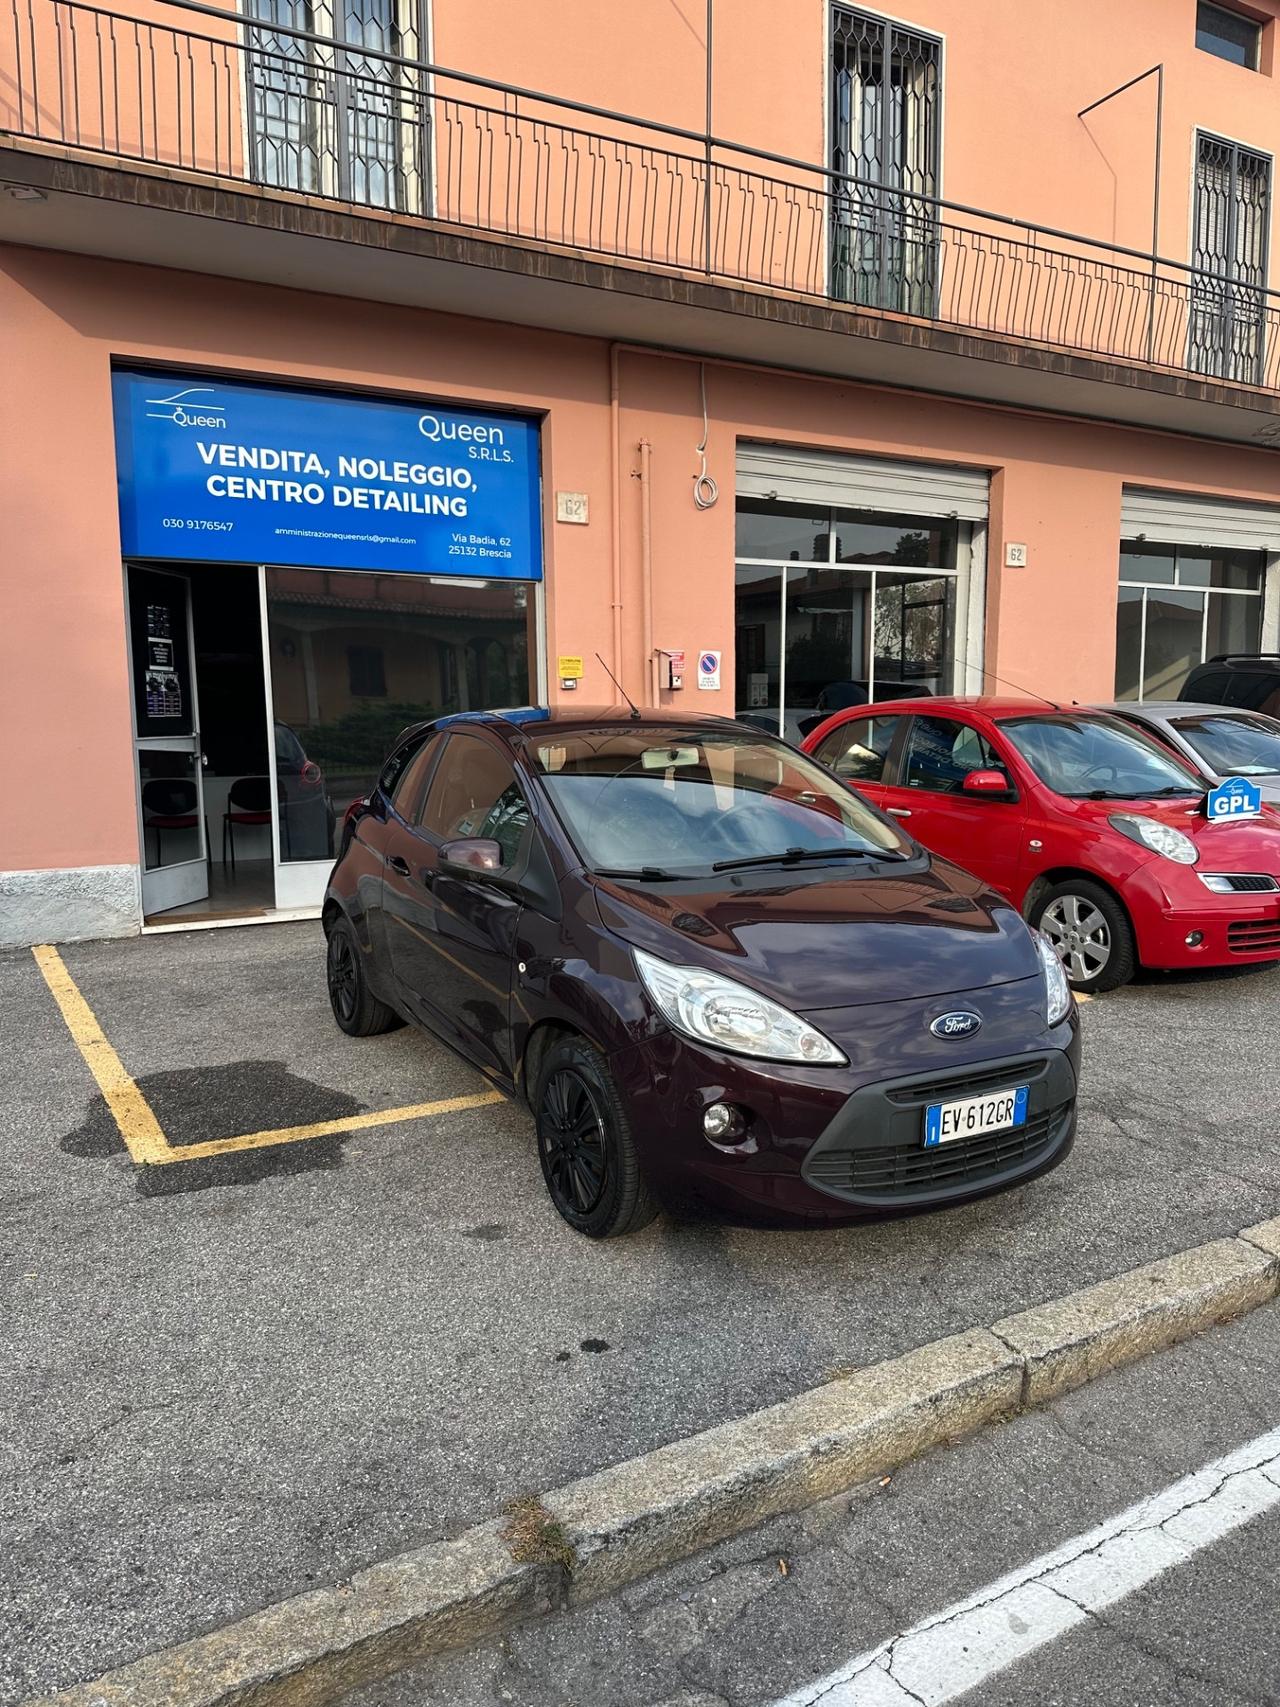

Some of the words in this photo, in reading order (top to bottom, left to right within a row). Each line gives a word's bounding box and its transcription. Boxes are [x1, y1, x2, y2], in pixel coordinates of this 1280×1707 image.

[172, 411, 226, 428] Queen
[418, 415, 504, 445] Queen
[468, 446, 514, 463] S.R.L.S.
[196, 442, 330, 478] VENDITA,
[338, 456, 478, 493] NOLEGGIO,
[206, 474, 325, 505] CENTRO
[333, 485, 468, 517] DETAILING
[162, 518, 184, 528] 030
[186, 519, 233, 531] 9176547
[274, 527, 417, 544] amministrazionequeensrls@gmail.com
[452, 533, 467, 543] Via
[469, 535, 498, 546] Badia,
[499, 537, 512, 546] 62
[448, 545, 477, 556] 25132
[479, 547, 512, 559] Brescia
[1010, 548, 1022, 561] 62
[1214, 795, 1255, 814] GPL
[944, 1016, 972, 1033] Ford
[941, 1108, 962, 1135] EV
[966, 1097, 1014, 1130] 612GR
